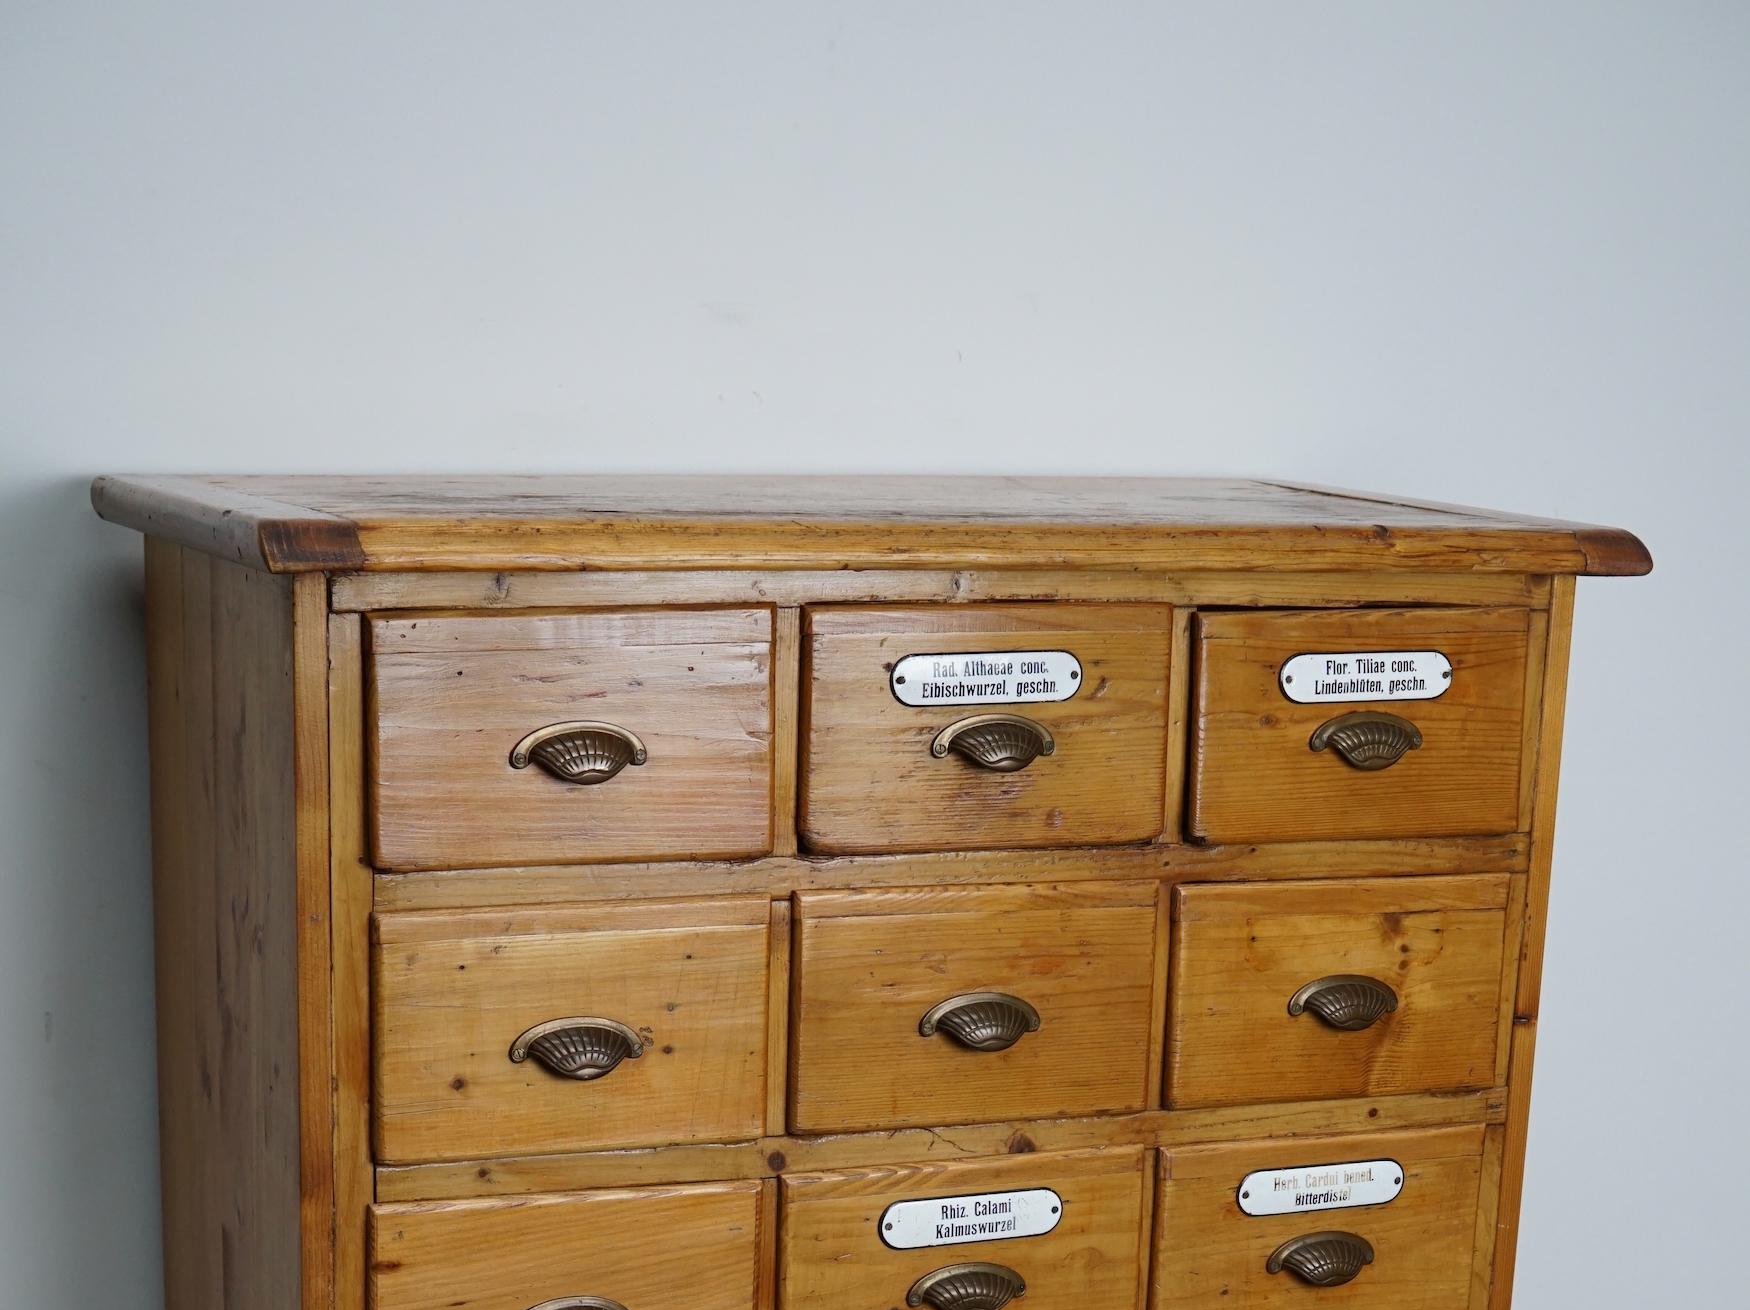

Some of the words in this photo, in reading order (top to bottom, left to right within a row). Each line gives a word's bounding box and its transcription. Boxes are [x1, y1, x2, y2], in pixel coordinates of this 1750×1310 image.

[933, 661, 959, 678] Rad.
[964, 660, 1013, 677] Althaeae
[1020, 660, 1049, 674] conc.
[1326, 660, 1351, 676] Flor.
[1356, 658, 1386, 674] Tiliae
[1391, 659, 1417, 673] conc.
[922, 679, 1009, 699] Eibischwurzel,
[1016, 680, 1059, 697] geschn.
[1314, 678, 1384, 695] Lindenblüten,
[1389, 676, 1427, 695] geschn.
[1273, 1177, 1301, 1192] Herb.
[1305, 1171, 1339, 1189] Cardui
[941, 1204, 969, 1220] Rhiz.
[974, 1198, 1012, 1217] Calami
[935, 1216, 1017, 1239] Kalmuswurzel
